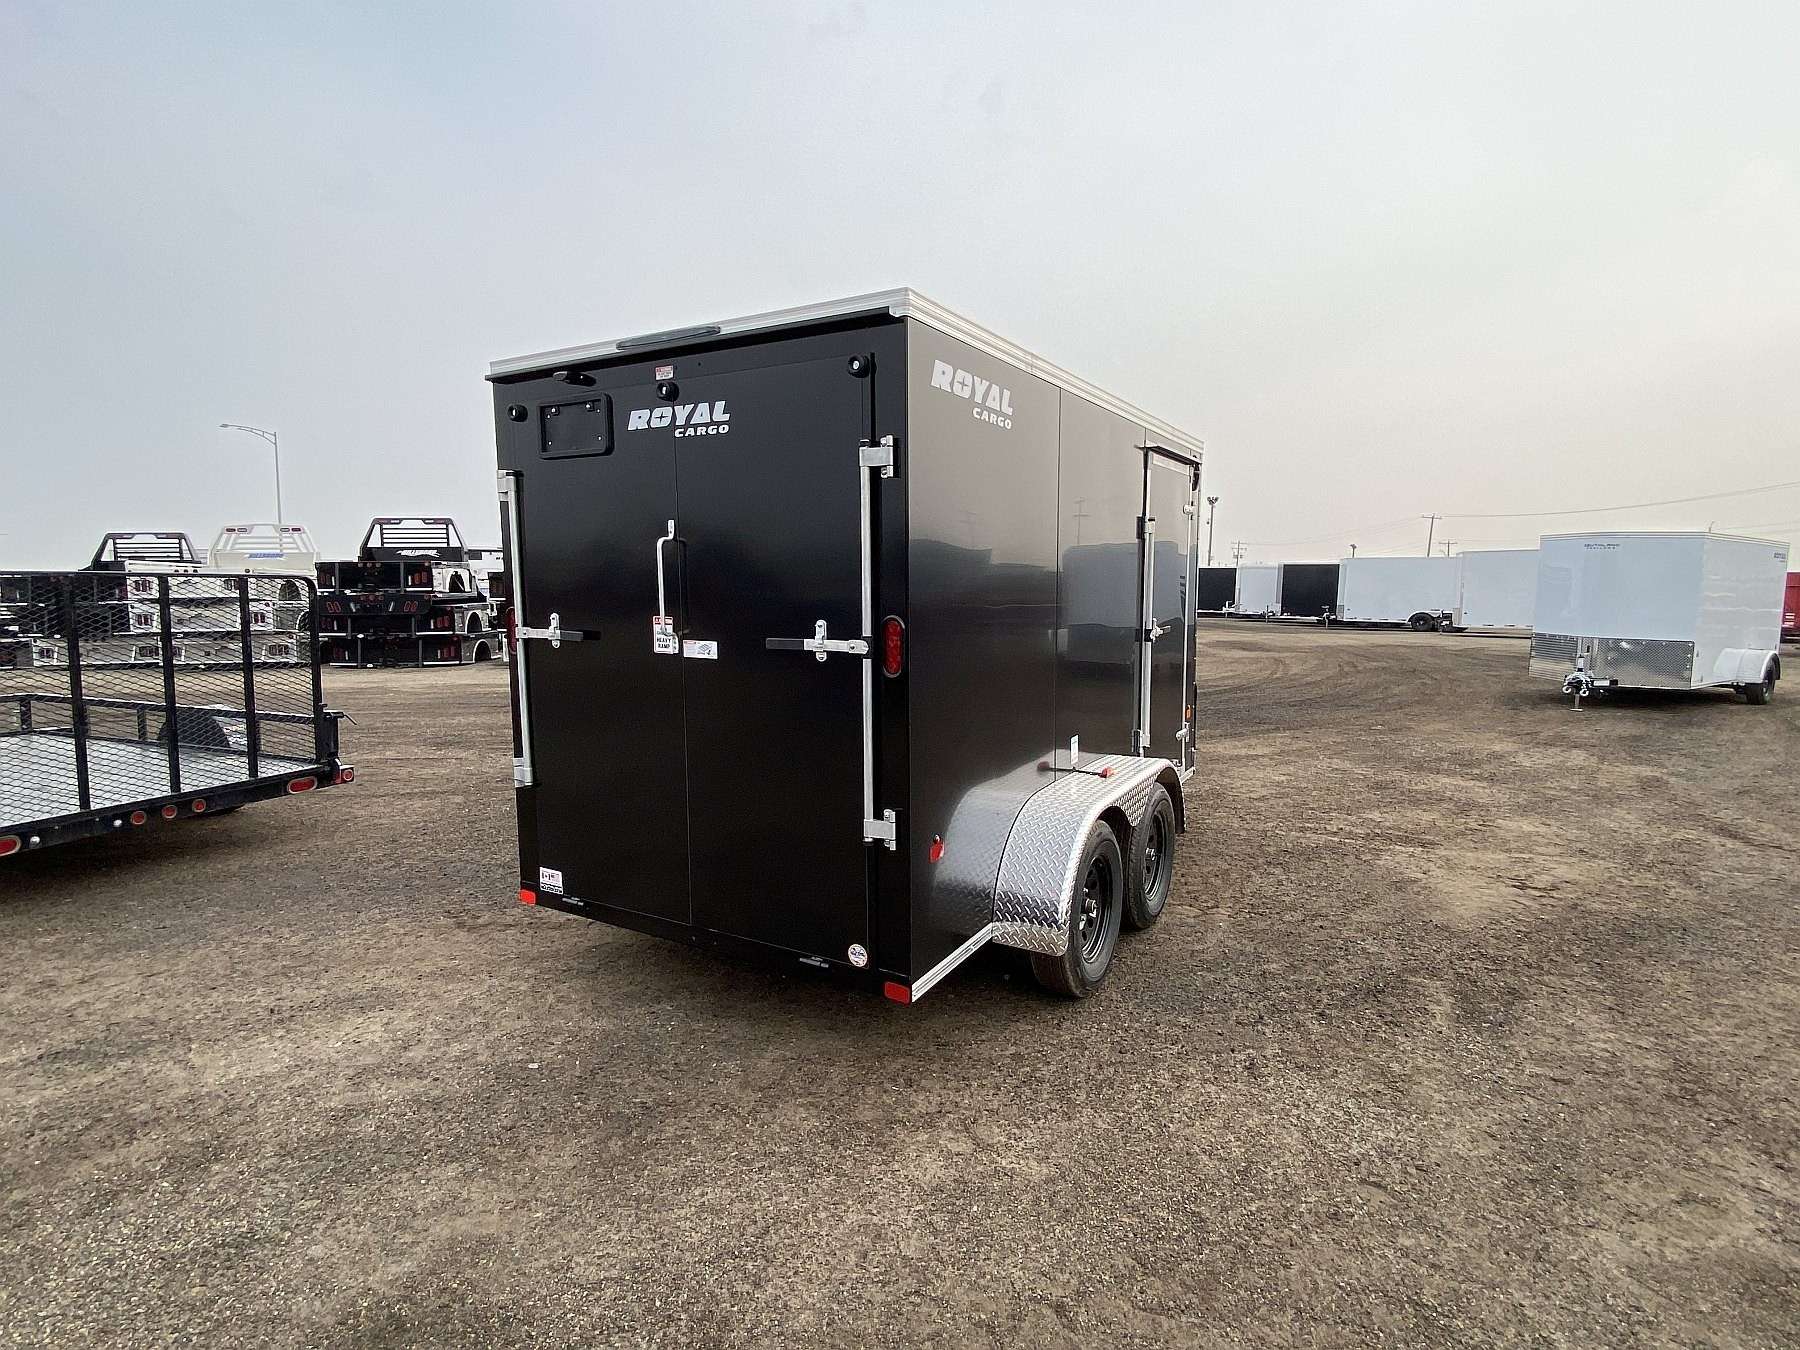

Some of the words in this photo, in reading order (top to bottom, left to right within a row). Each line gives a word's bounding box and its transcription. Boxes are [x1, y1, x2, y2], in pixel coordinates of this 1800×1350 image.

[931, 360, 1013, 416] ROYAL
[627, 401, 731, 431] ROYAL
[973, 407, 1012, 430] CARGO
[674, 424, 730, 438] CARGO
